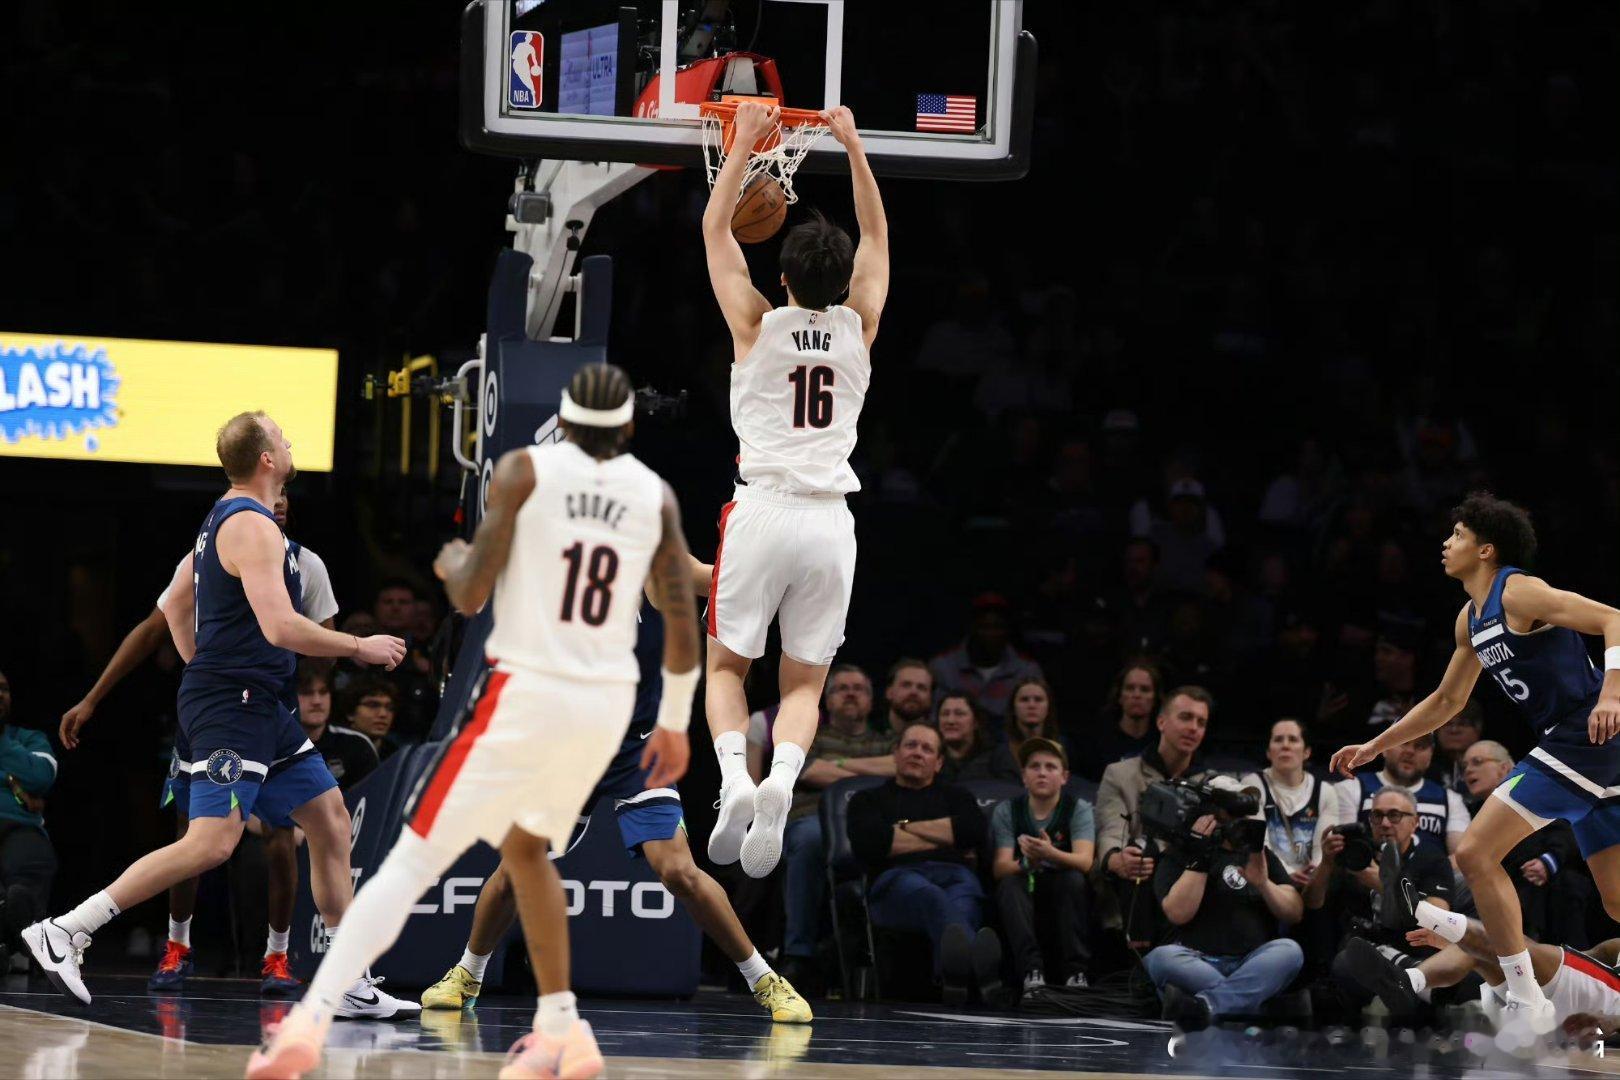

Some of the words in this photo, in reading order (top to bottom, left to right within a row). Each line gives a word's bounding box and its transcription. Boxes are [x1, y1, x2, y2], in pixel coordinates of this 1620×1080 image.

[513, 89, 530, 103] NBA
[791, 329, 832, 352] YANG
[0, 361, 101, 411] LASH
[788, 365, 835, 429] 16
[560, 540, 619, 627] 18
